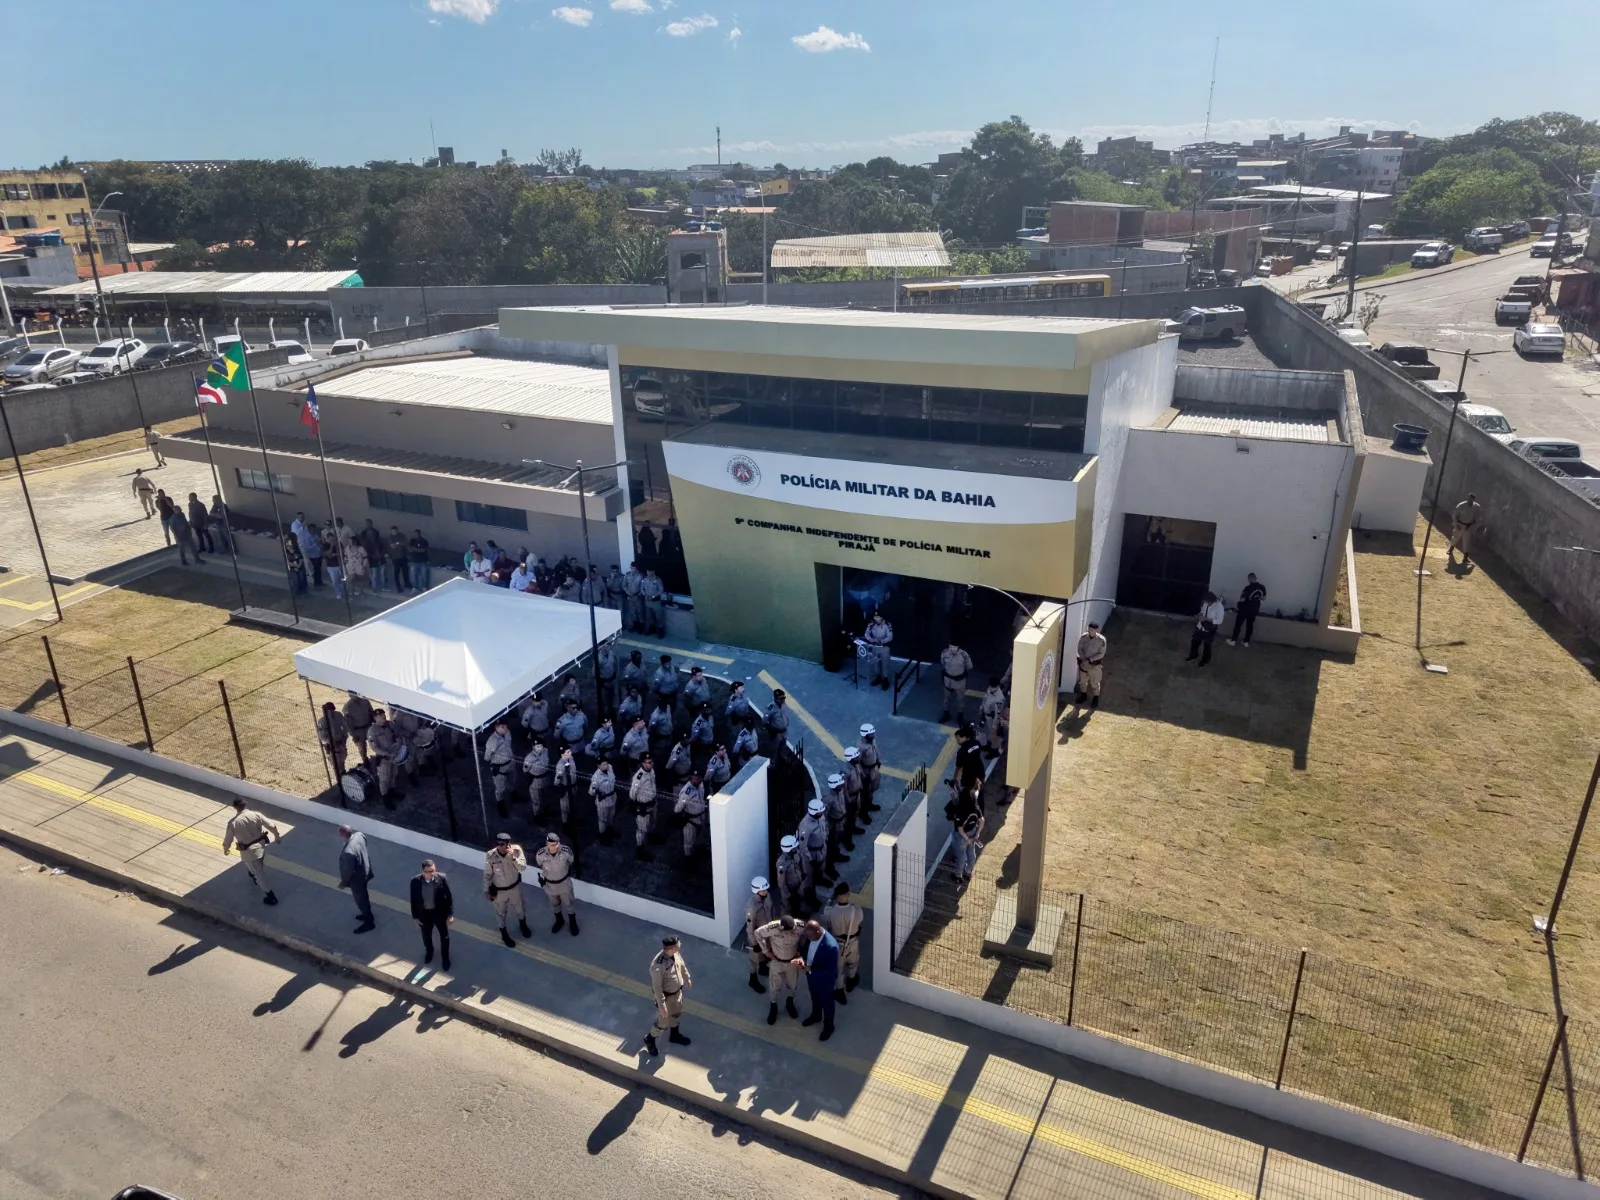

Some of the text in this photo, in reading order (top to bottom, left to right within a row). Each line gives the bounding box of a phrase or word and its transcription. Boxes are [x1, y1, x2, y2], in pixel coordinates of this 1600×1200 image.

[780, 474, 996, 508] POLÍCIA MILITAR DA BAHIA
[747, 519, 803, 534] COMPANHIA
[805, 527, 880, 544] INDEPENDENTE
[883, 538, 896, 547] DE
[899, 540, 943, 552] POLÍCIA
[946, 545, 991, 559] MILITAR
[838, 539, 876, 552] PIRAJÁ
